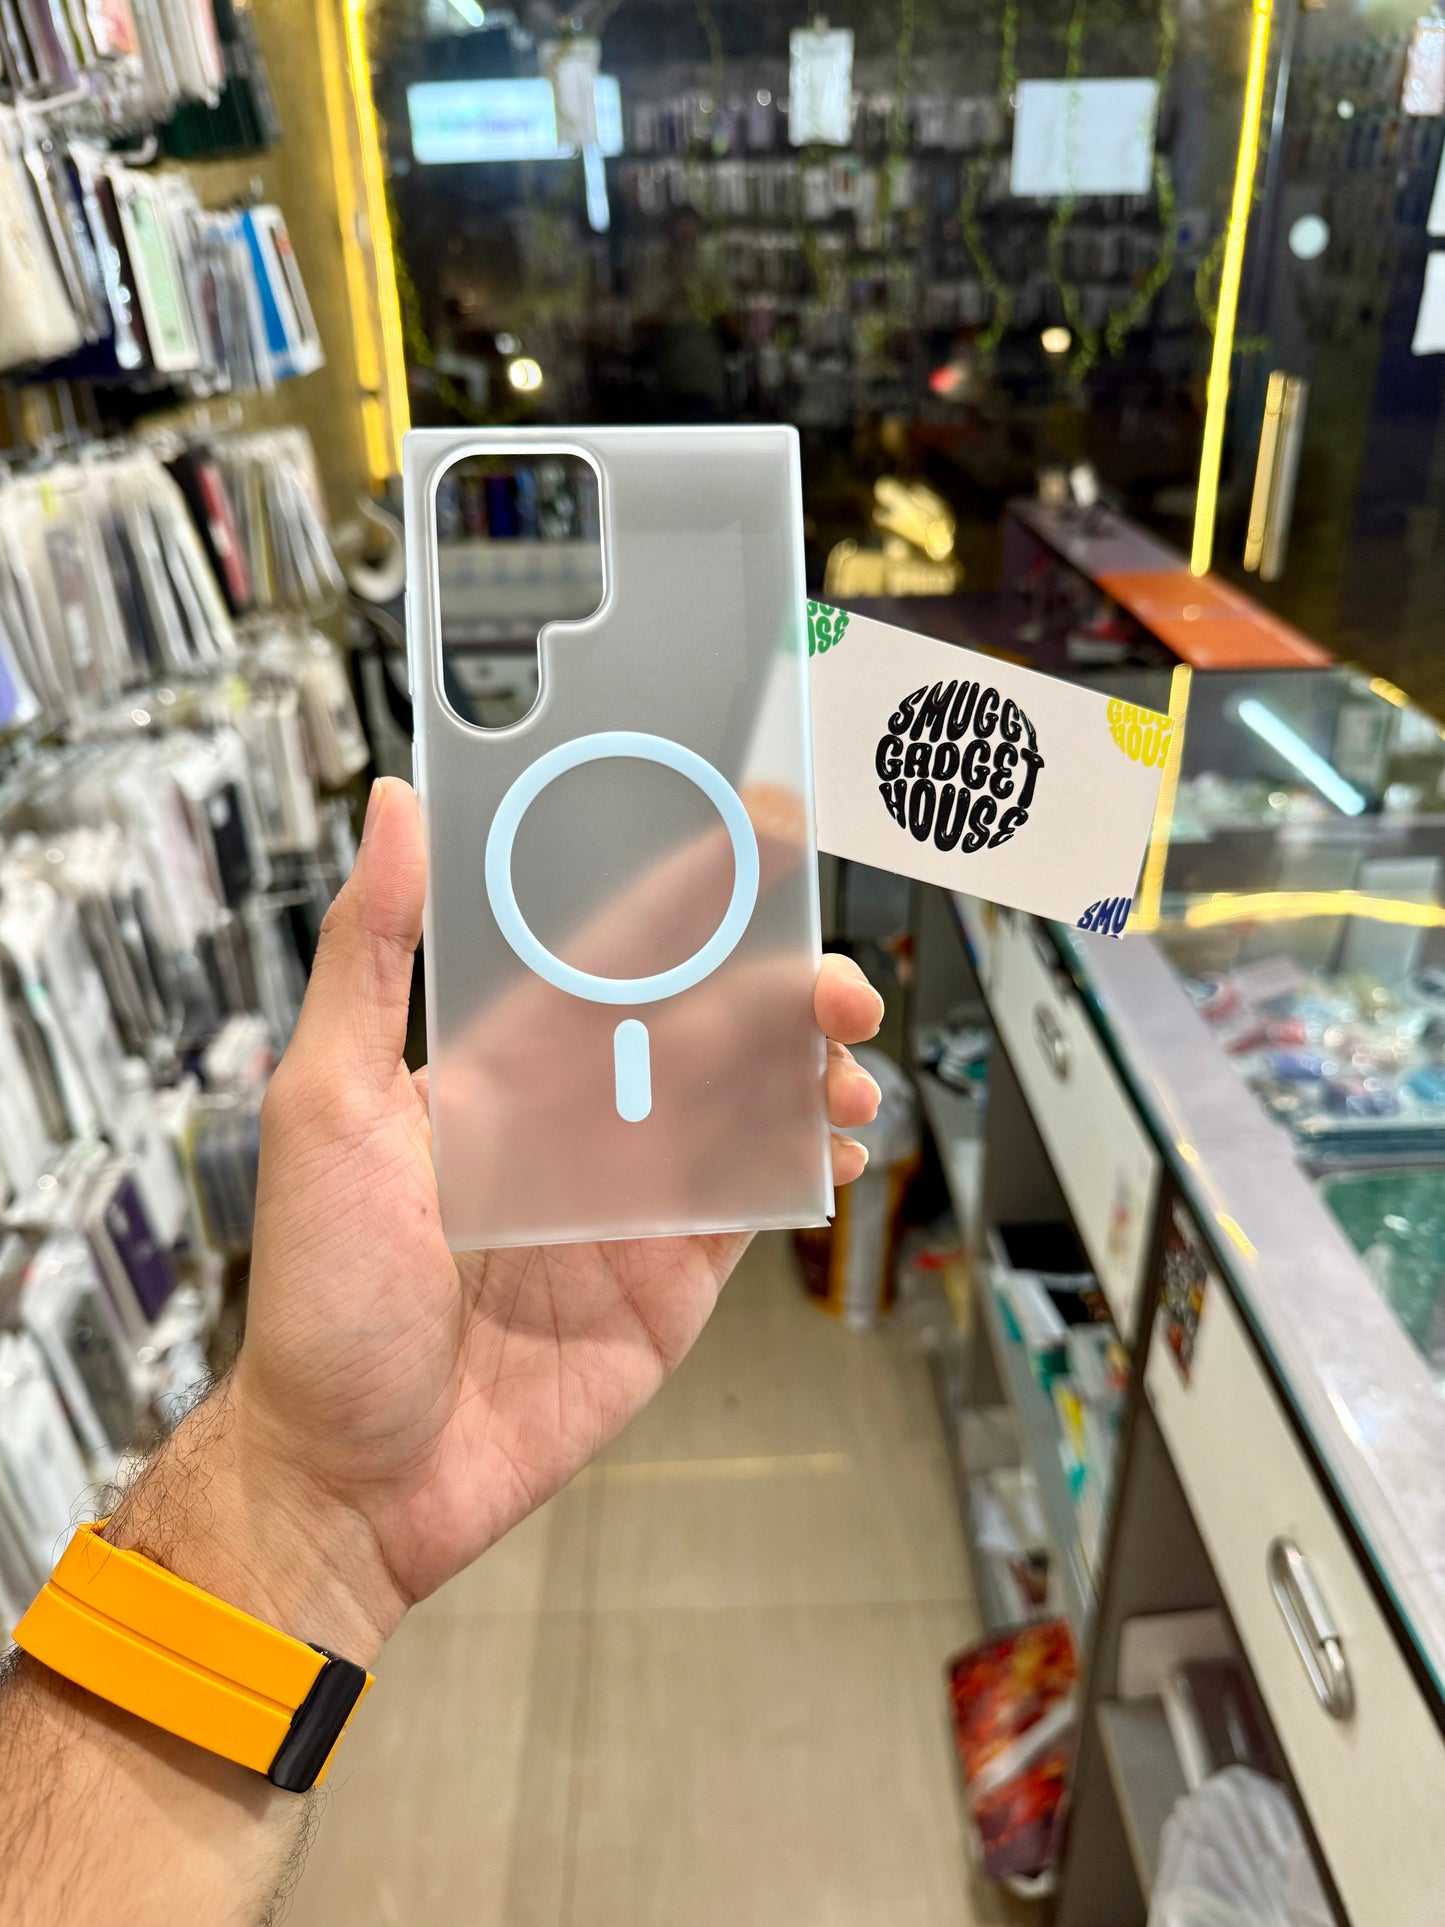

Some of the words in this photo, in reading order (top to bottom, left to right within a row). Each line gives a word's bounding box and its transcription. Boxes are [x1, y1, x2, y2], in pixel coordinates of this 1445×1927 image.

[888, 680, 1039, 753] SMUGGY
[875, 734, 1045, 809] GADGET
[879, 779, 1029, 853] HOUSE
[1077, 896, 1132, 935] SMU
